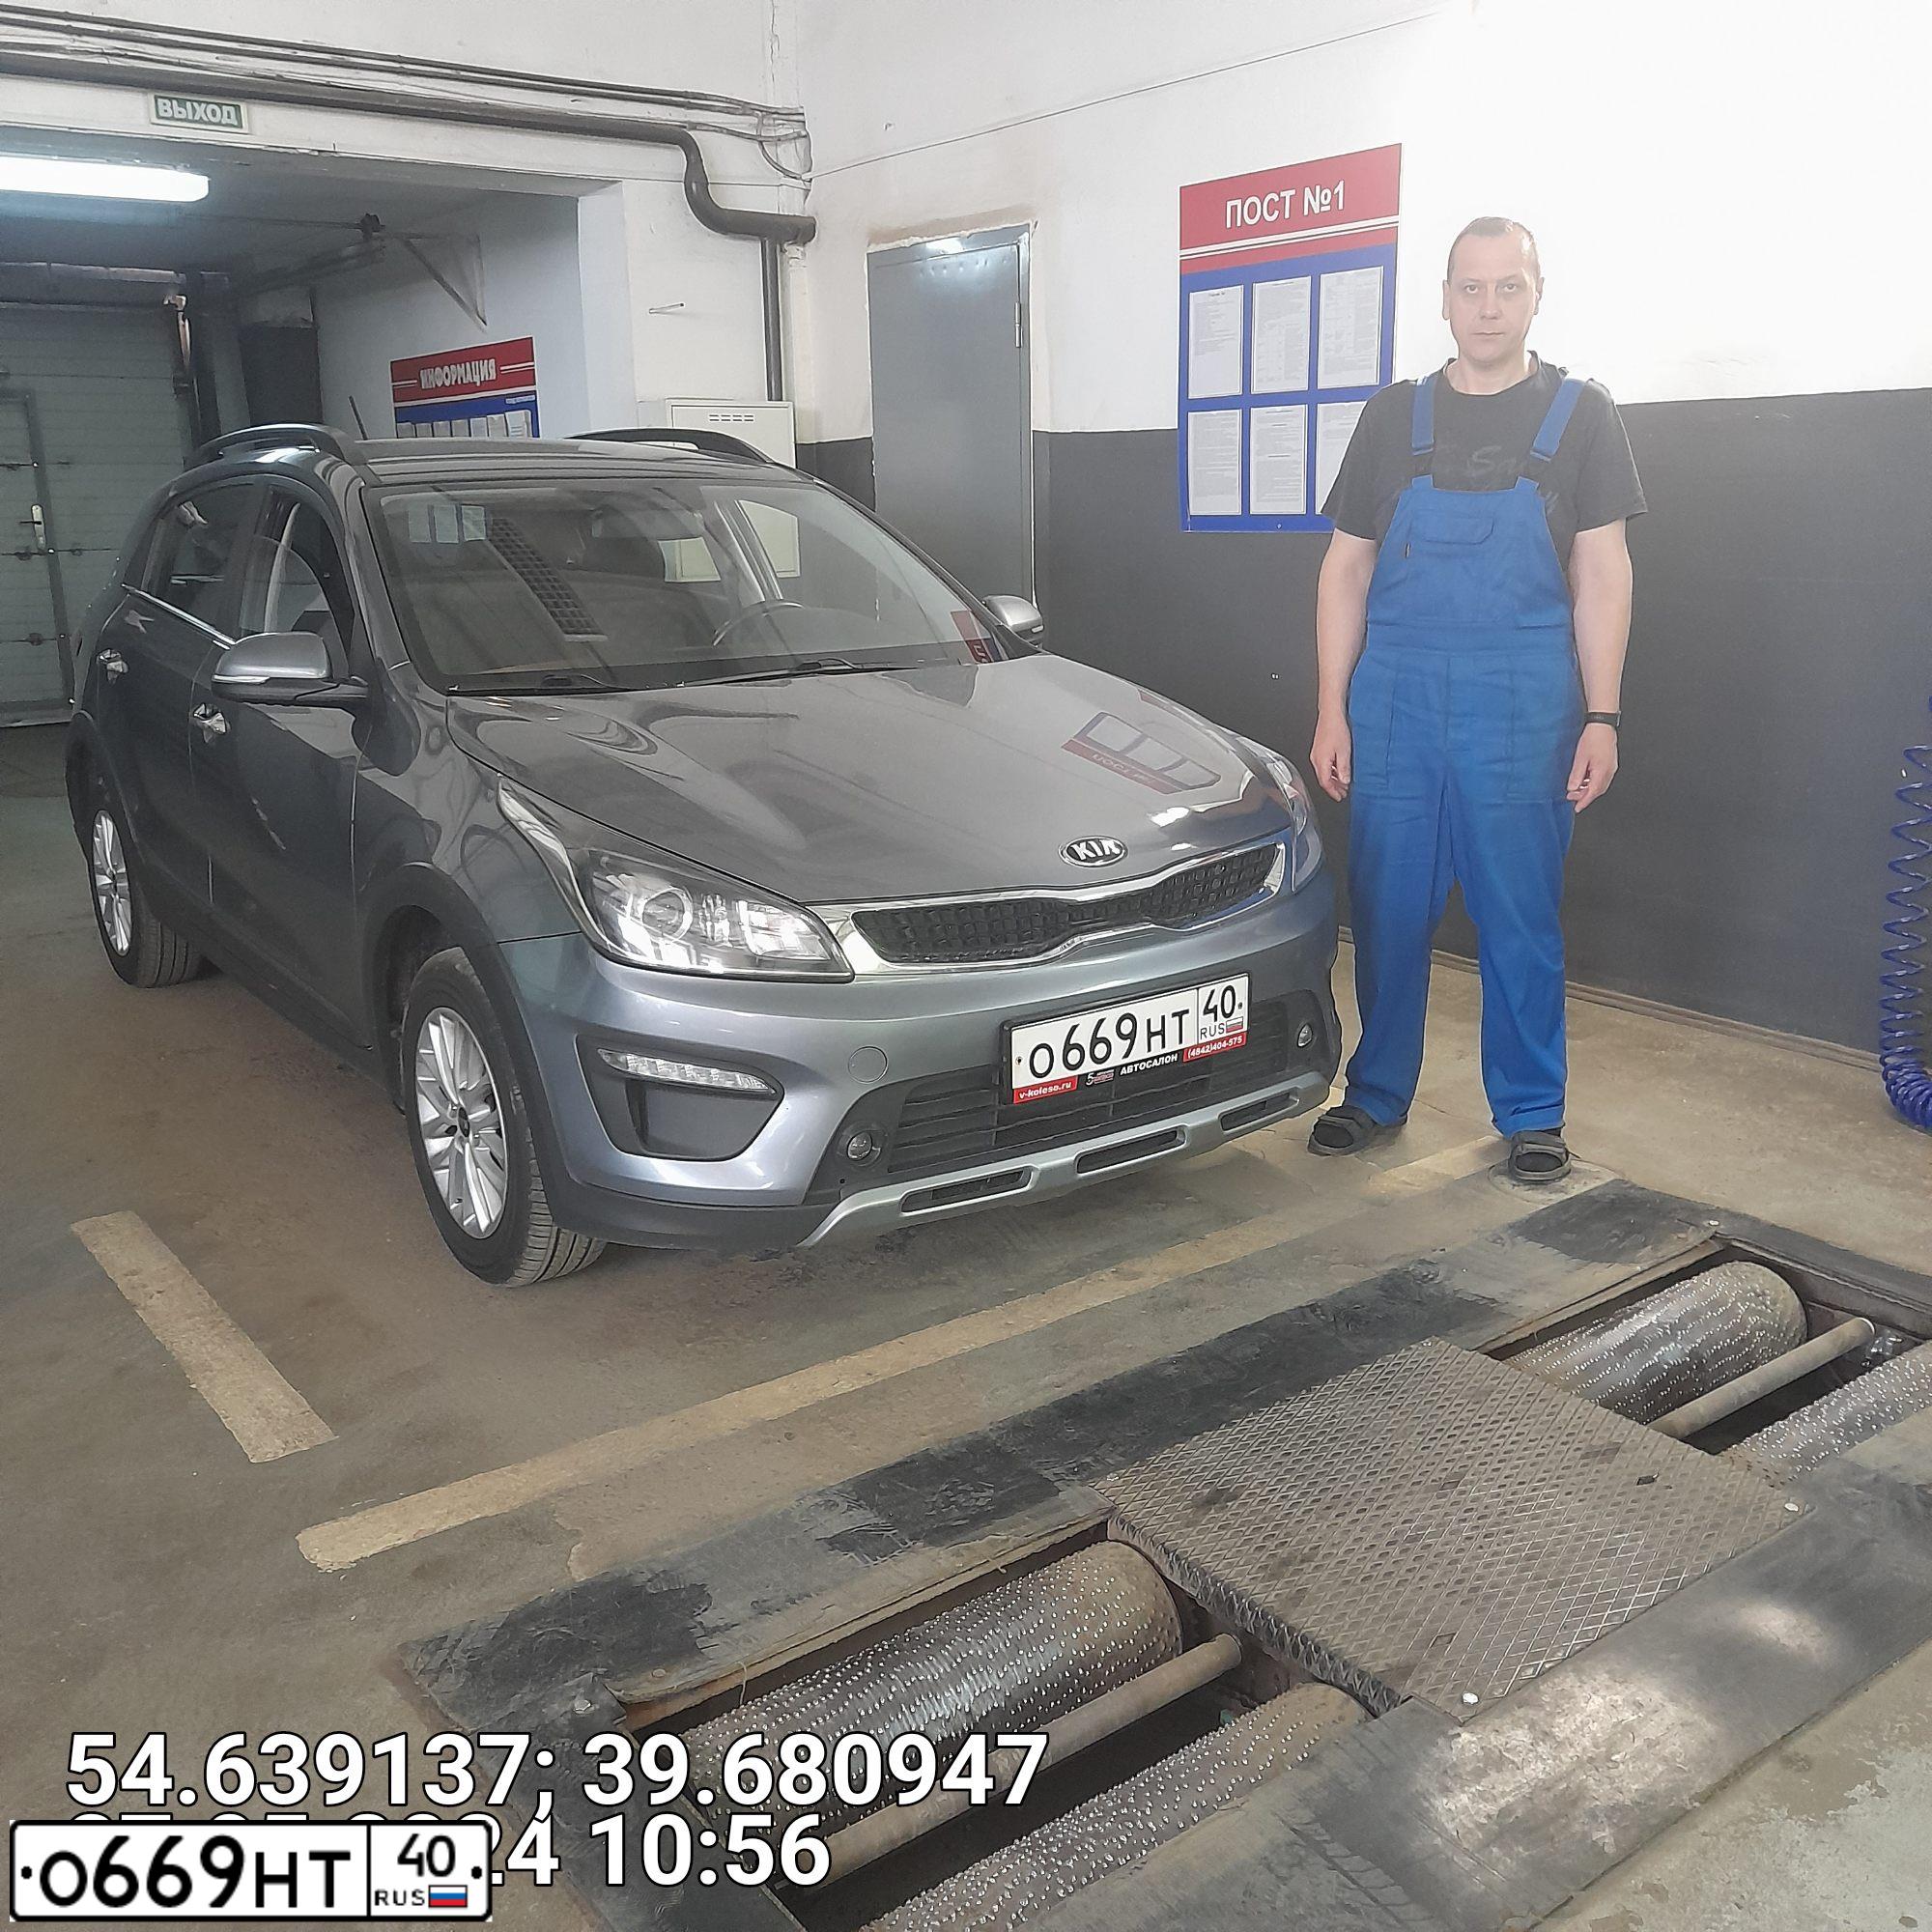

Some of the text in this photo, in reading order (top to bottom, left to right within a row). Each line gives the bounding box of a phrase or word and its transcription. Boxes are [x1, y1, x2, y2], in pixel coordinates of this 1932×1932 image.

[156, 98, 238, 126] ВЫХОД
[1226, 180, 1345, 228] ПОСТ №1
[419, 358, 497, 389] ИНФОРМАЦИЯ
[1070, 838, 1121, 861] KIA
[1203, 984, 1236, 1022] 40
[1200, 1022, 1225, 1040] RUS
[1120, 1053, 1179, 1076] АВТОСАЛОН
[1018, 1081, 1072, 1099] v-koleso.ru
